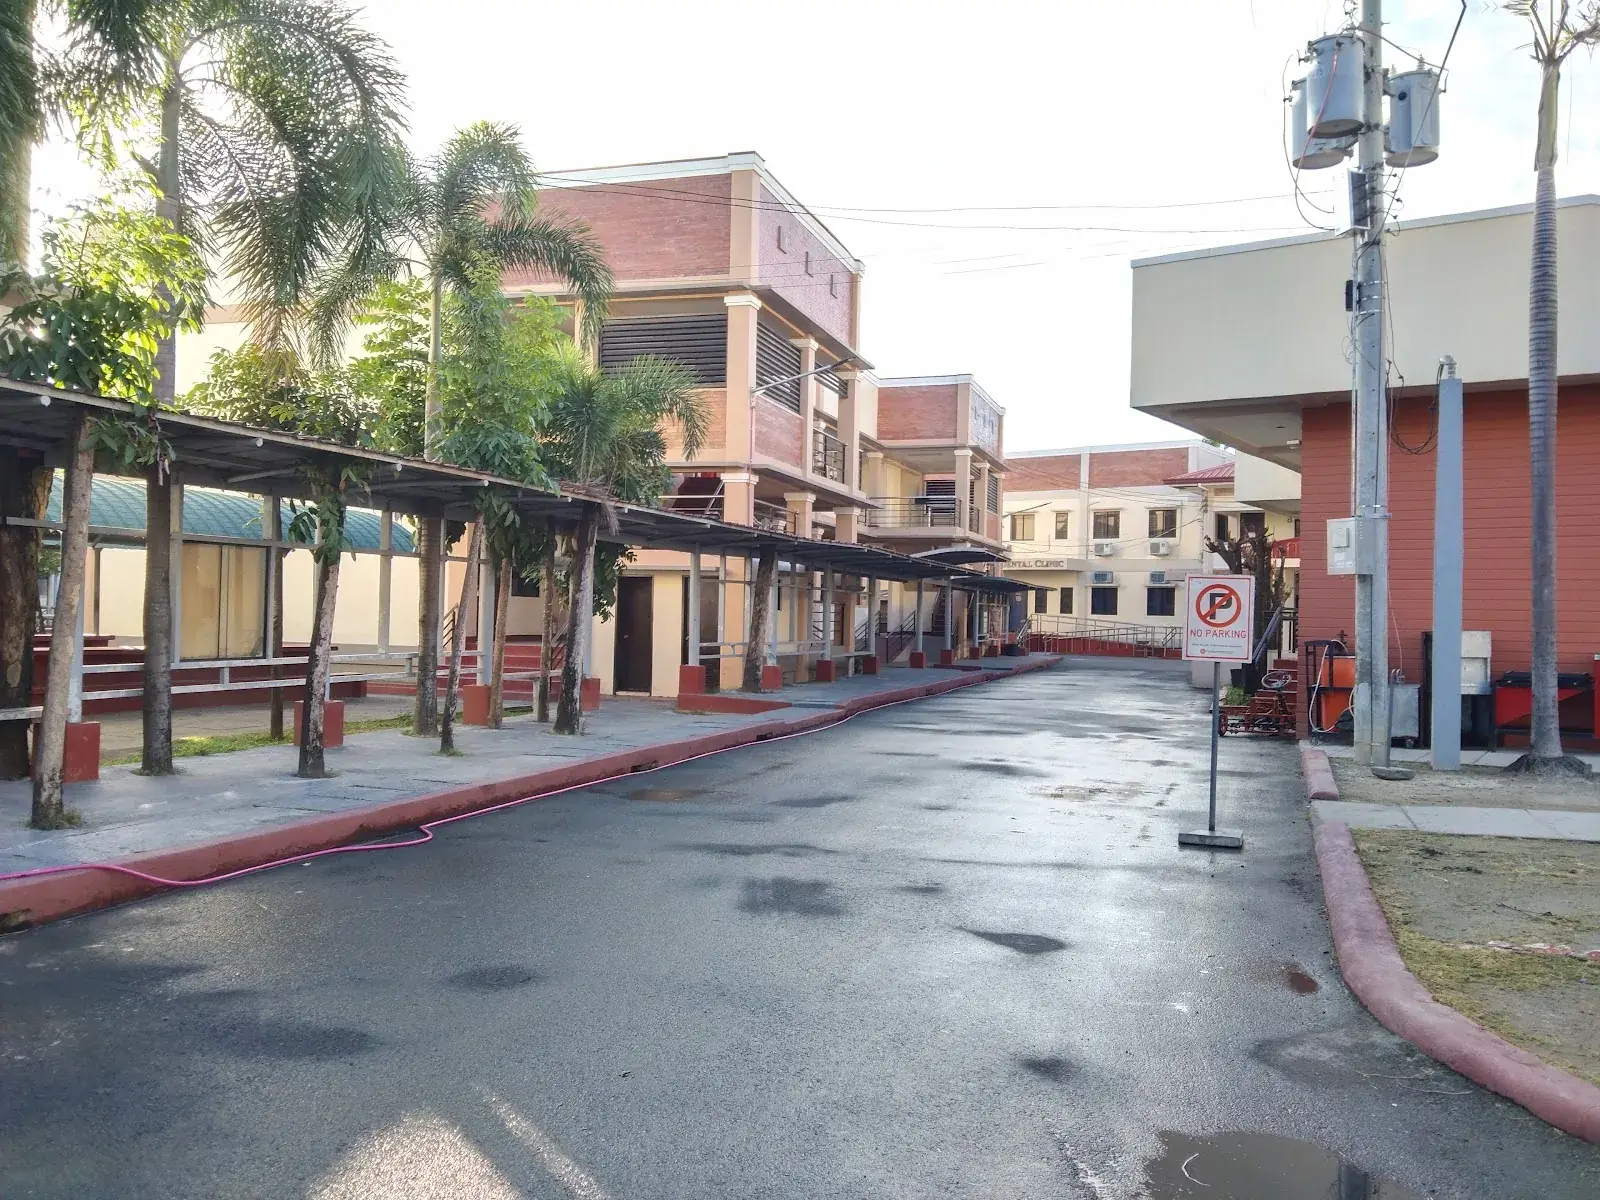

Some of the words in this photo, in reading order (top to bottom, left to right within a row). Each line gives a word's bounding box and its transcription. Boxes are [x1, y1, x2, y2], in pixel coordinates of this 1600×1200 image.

[1209, 593, 1232, 620] P
[1190, 629, 1203, 637] NO
[1205, 629, 1247, 639] PARKING
